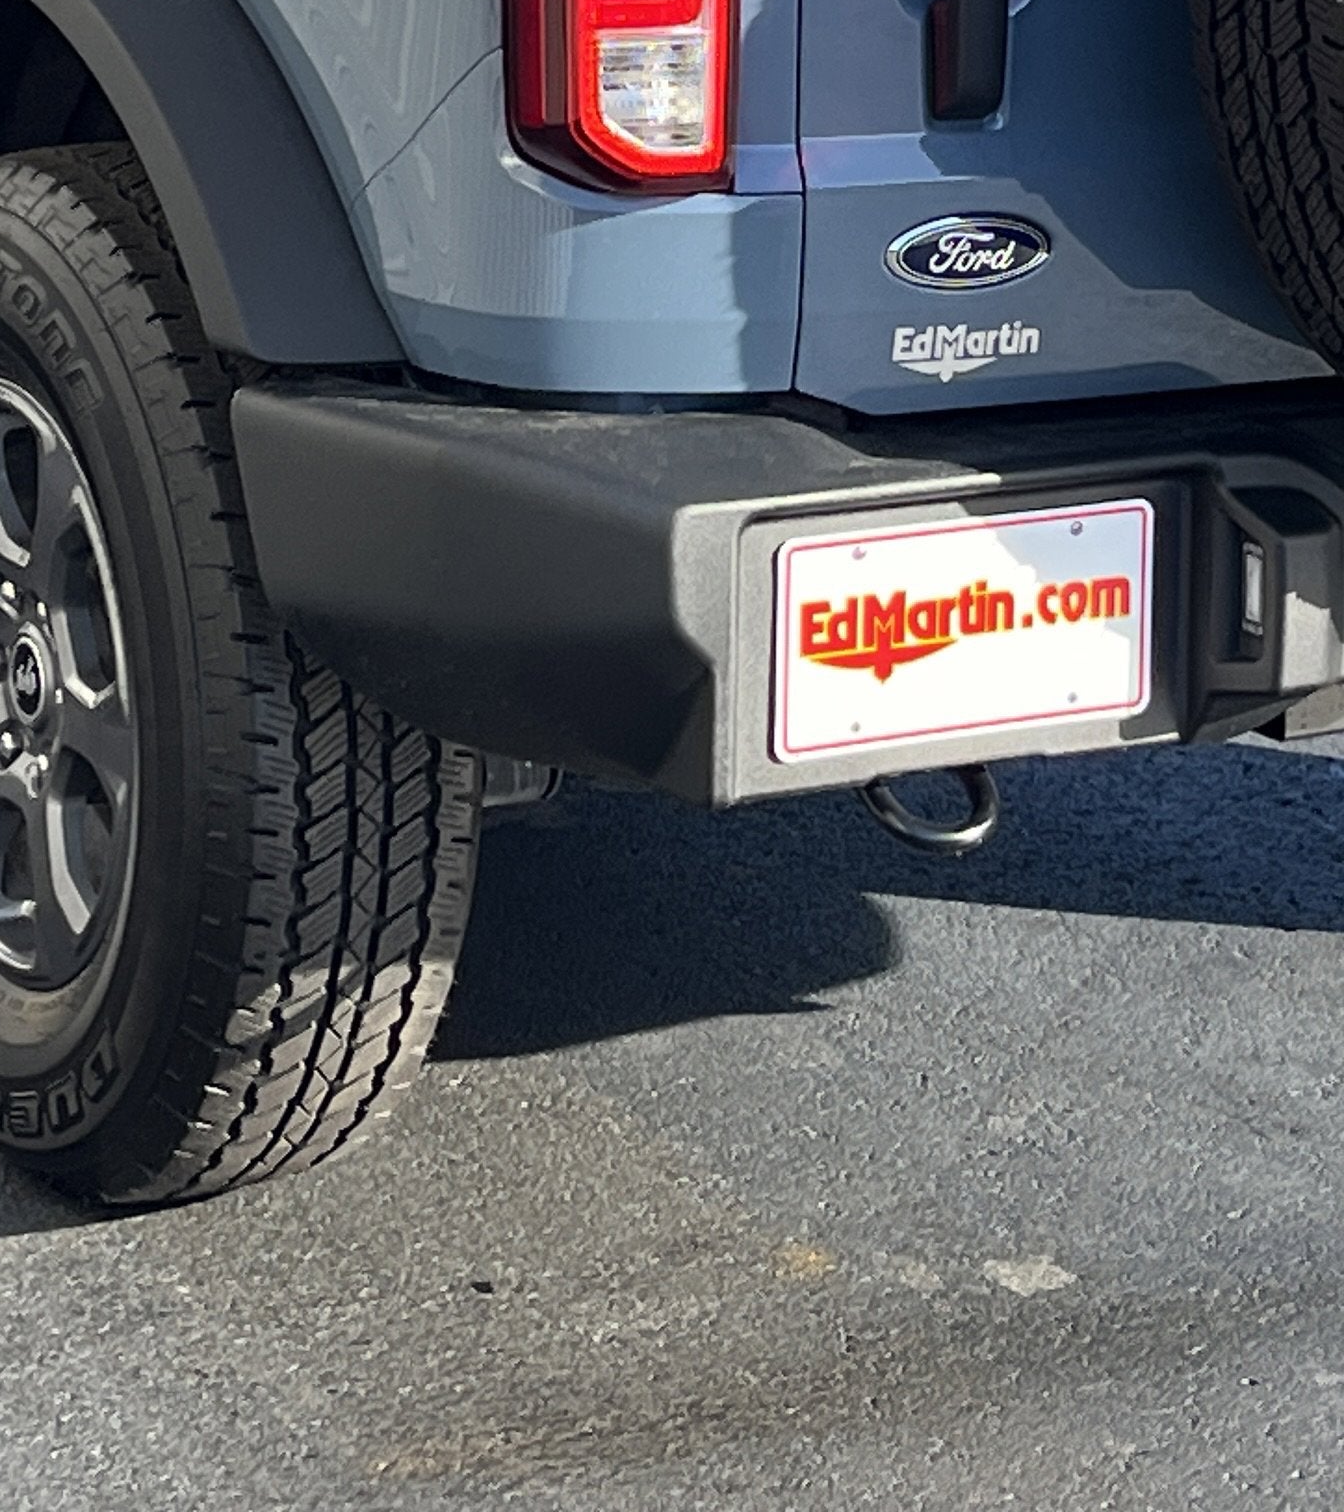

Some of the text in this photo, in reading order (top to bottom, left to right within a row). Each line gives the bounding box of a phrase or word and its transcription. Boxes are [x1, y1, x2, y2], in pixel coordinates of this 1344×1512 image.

[929, 231, 1017, 275] Ford
[892, 319, 1041, 366] EdMartin
[798, 574, 1132, 662] EdMartin.com
